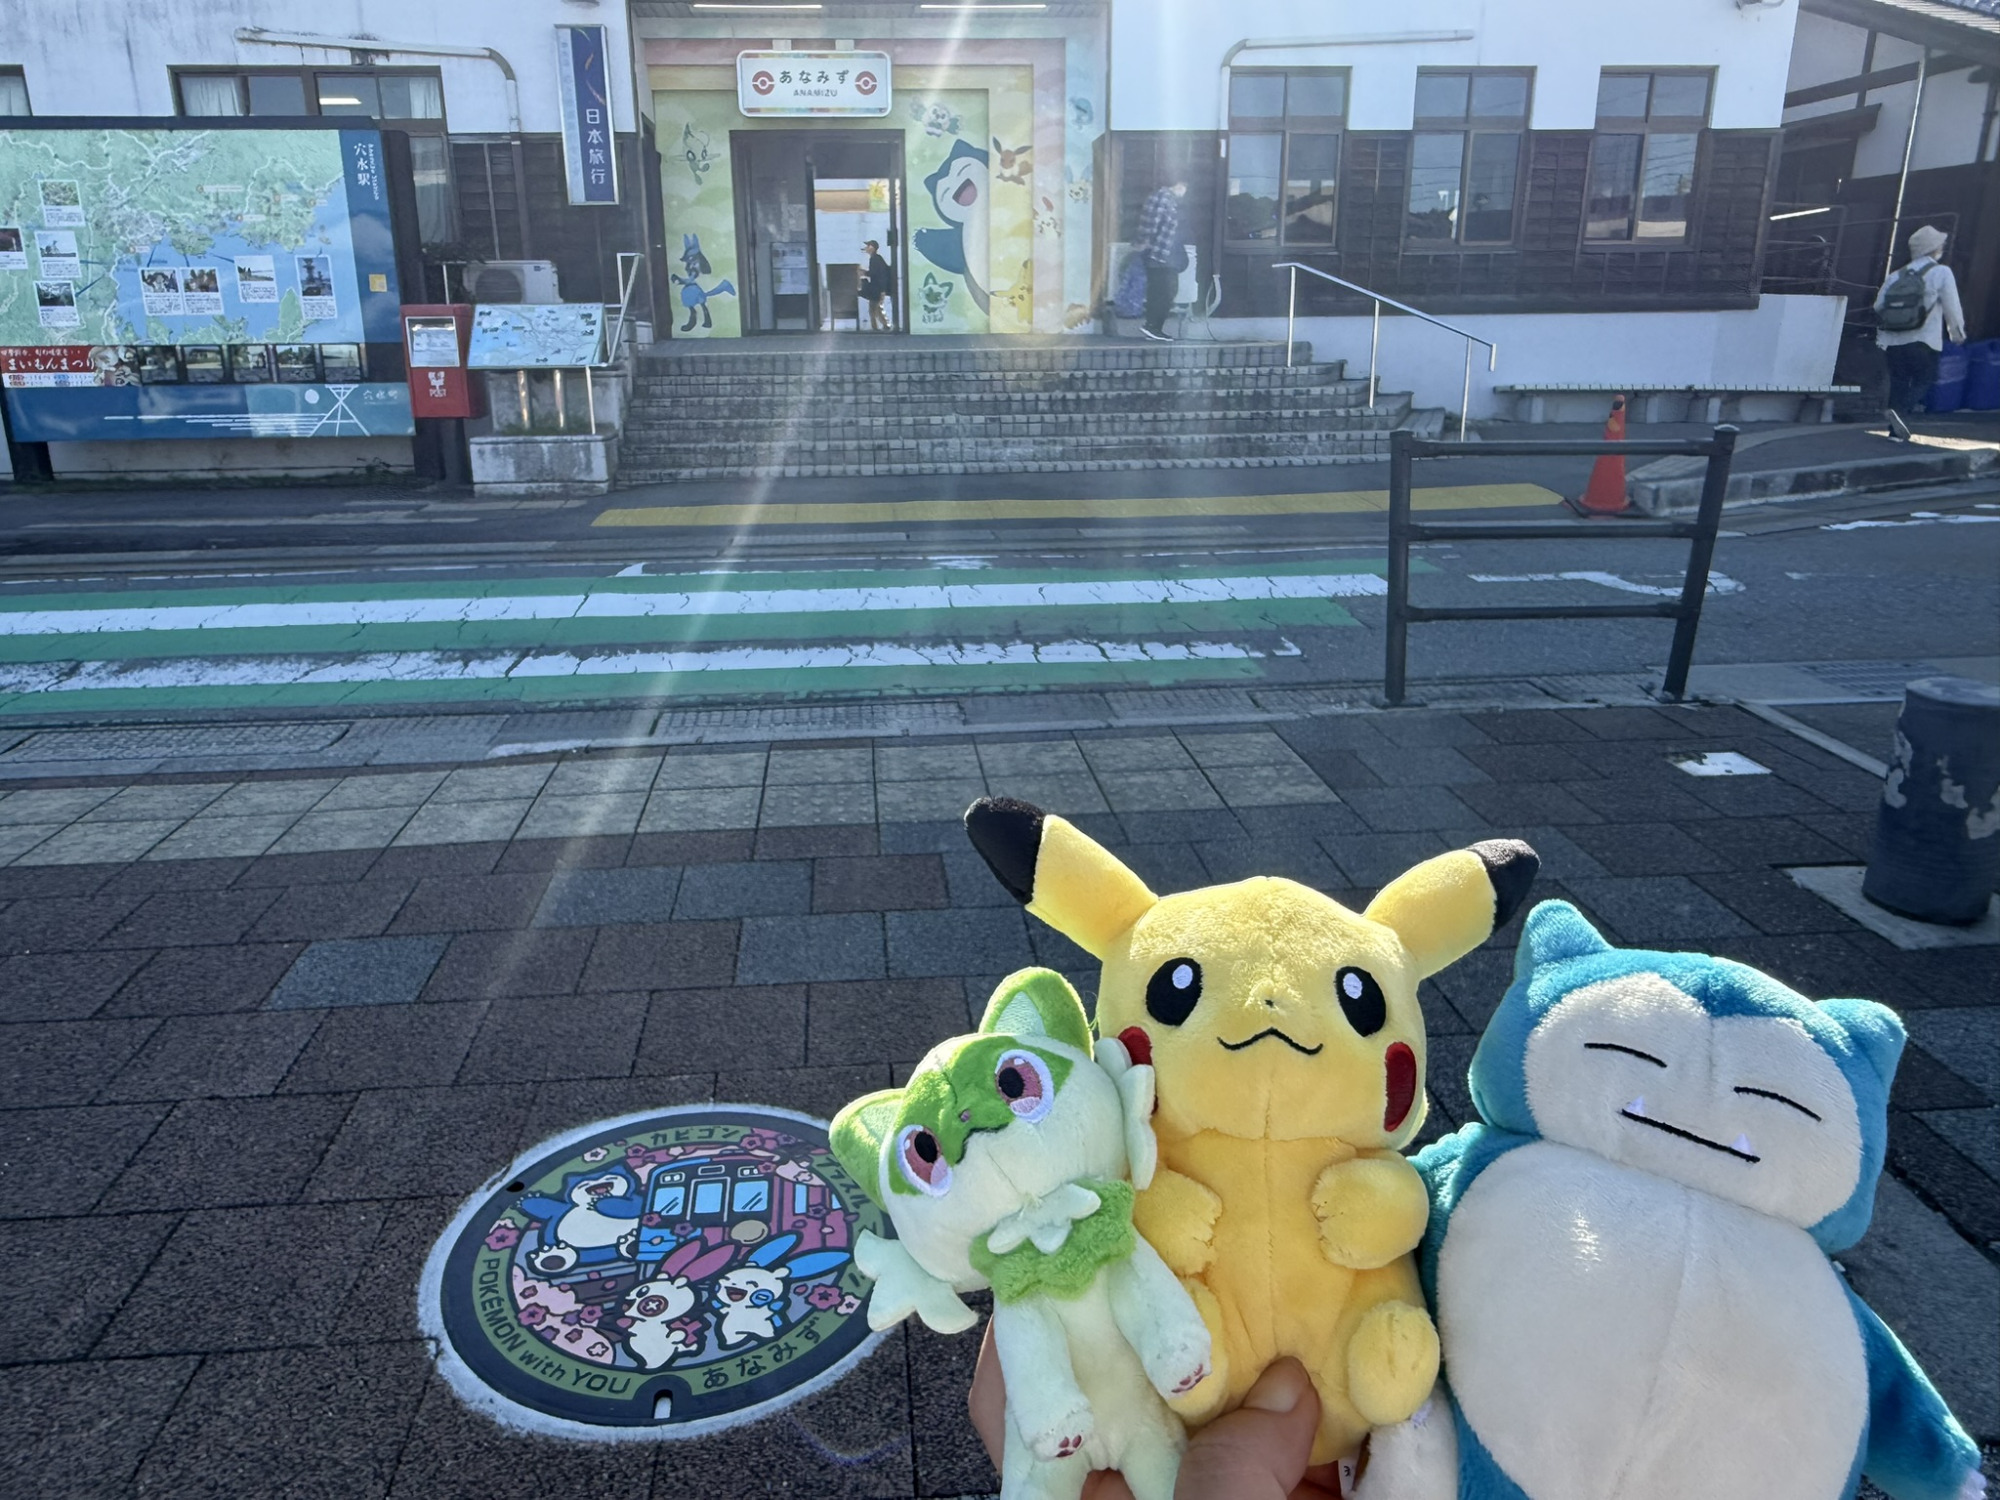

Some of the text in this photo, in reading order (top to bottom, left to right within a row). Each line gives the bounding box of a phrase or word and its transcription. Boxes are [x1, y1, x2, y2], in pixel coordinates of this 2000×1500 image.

[779, 69, 850, 85] あなみず
[793, 88, 838, 97] ANAMIZU
[586, 108, 606, 185] 日本旅行
[8, 358, 95, 371] まいもんまつり
[650, 1125, 740, 1146] カビゴン
[479, 1257, 631, 1394] POKÉMON with YOU
[702, 1316, 821, 1389] あなみず
